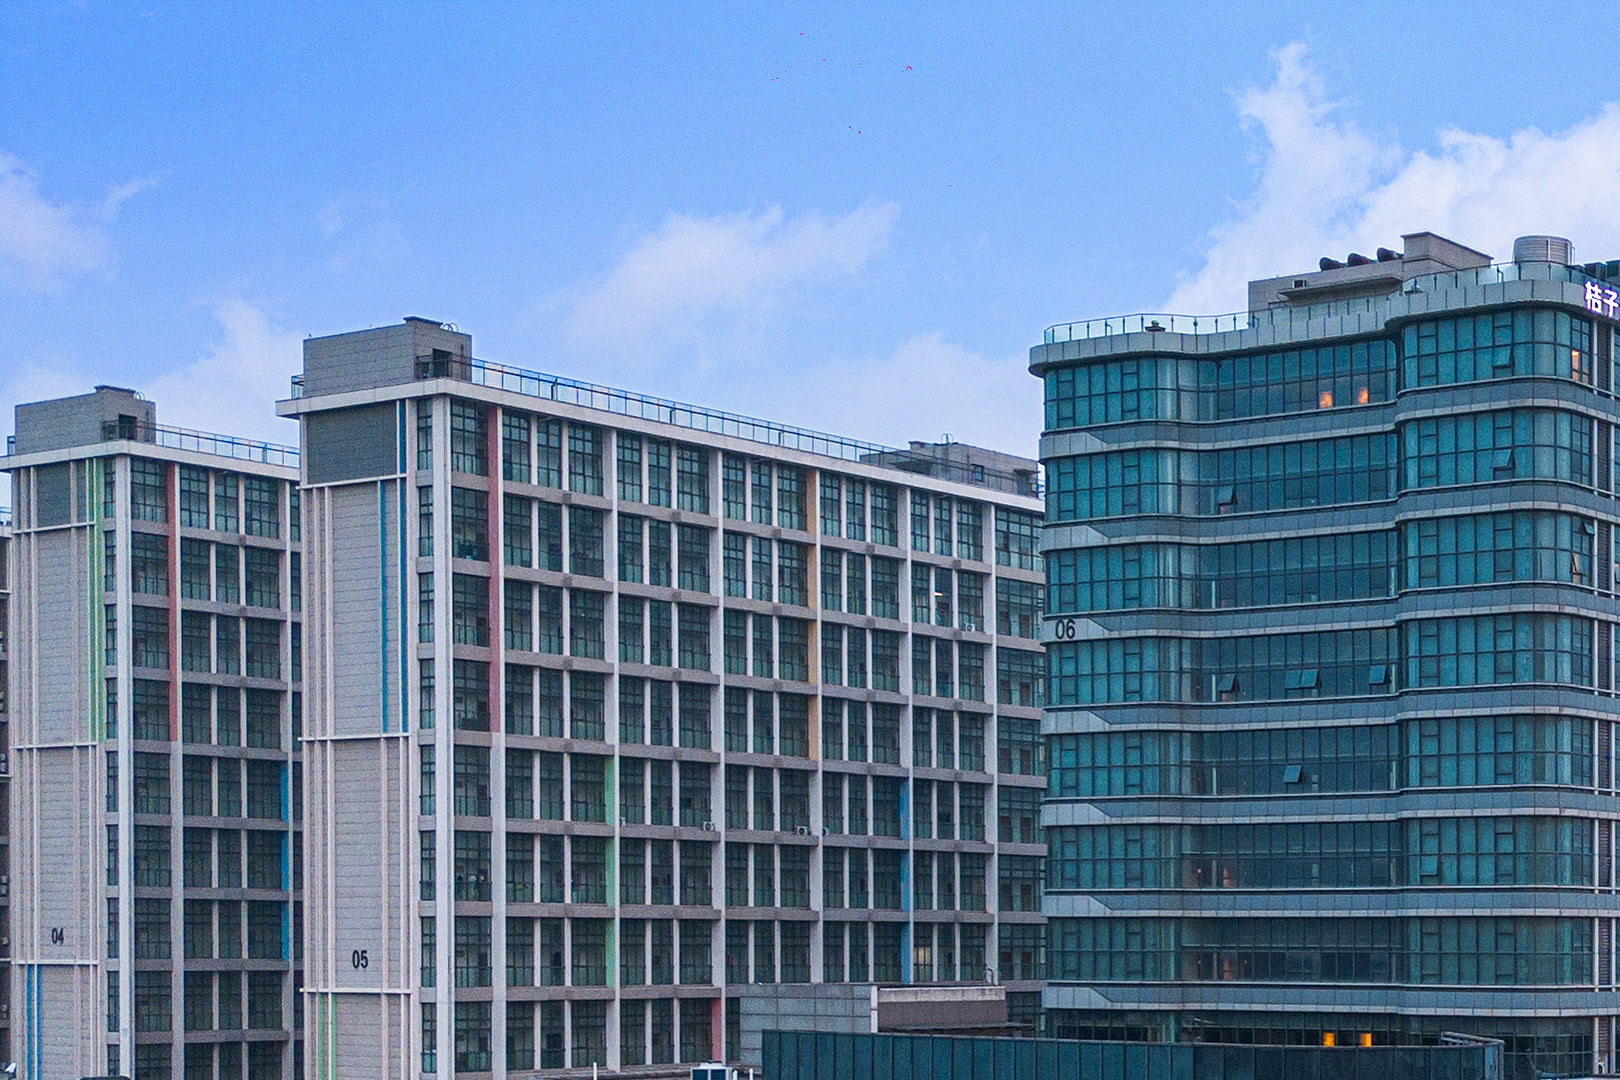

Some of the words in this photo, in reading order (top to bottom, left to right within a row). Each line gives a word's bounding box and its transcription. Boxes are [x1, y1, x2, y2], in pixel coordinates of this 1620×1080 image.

[1055, 617, 1076, 640] 06
[50, 926, 66, 945] 04
[351, 949, 370, 969] 05
